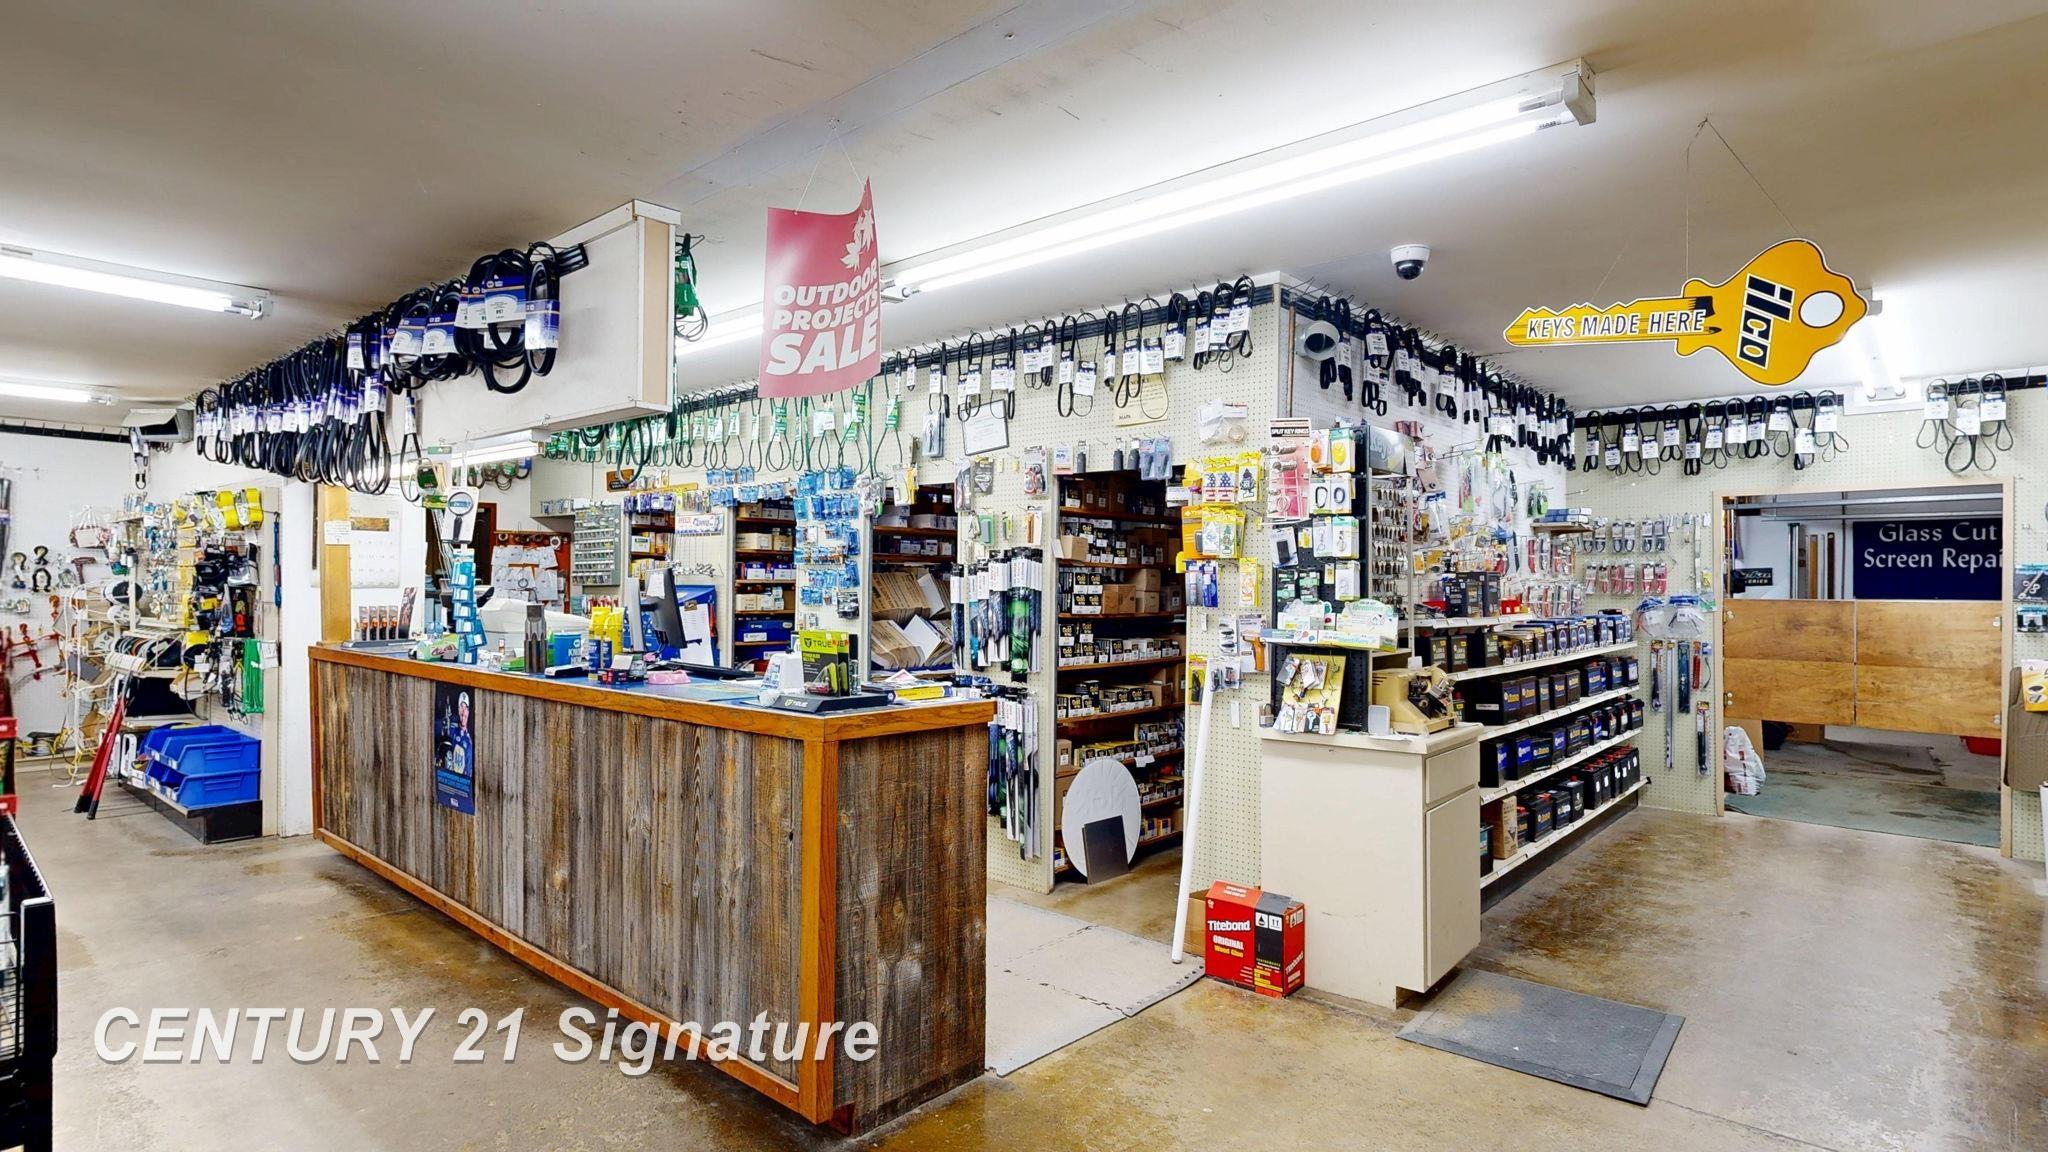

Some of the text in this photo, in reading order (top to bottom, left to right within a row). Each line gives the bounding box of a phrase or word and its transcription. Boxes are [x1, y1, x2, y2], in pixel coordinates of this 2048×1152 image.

[774, 257, 878, 307] OUTDOOR
[772, 282, 878, 331] PROJECTS
[1527, 309, 1706, 339] KEYS MADE HERE
[765, 306, 879, 376] SALE
[1879, 522, 1998, 543] Glass Cut
[1863, 548, 1933, 568] Screen
[813, 639, 834, 648] TRUE
[1207, 919, 1251, 932] Titebond
